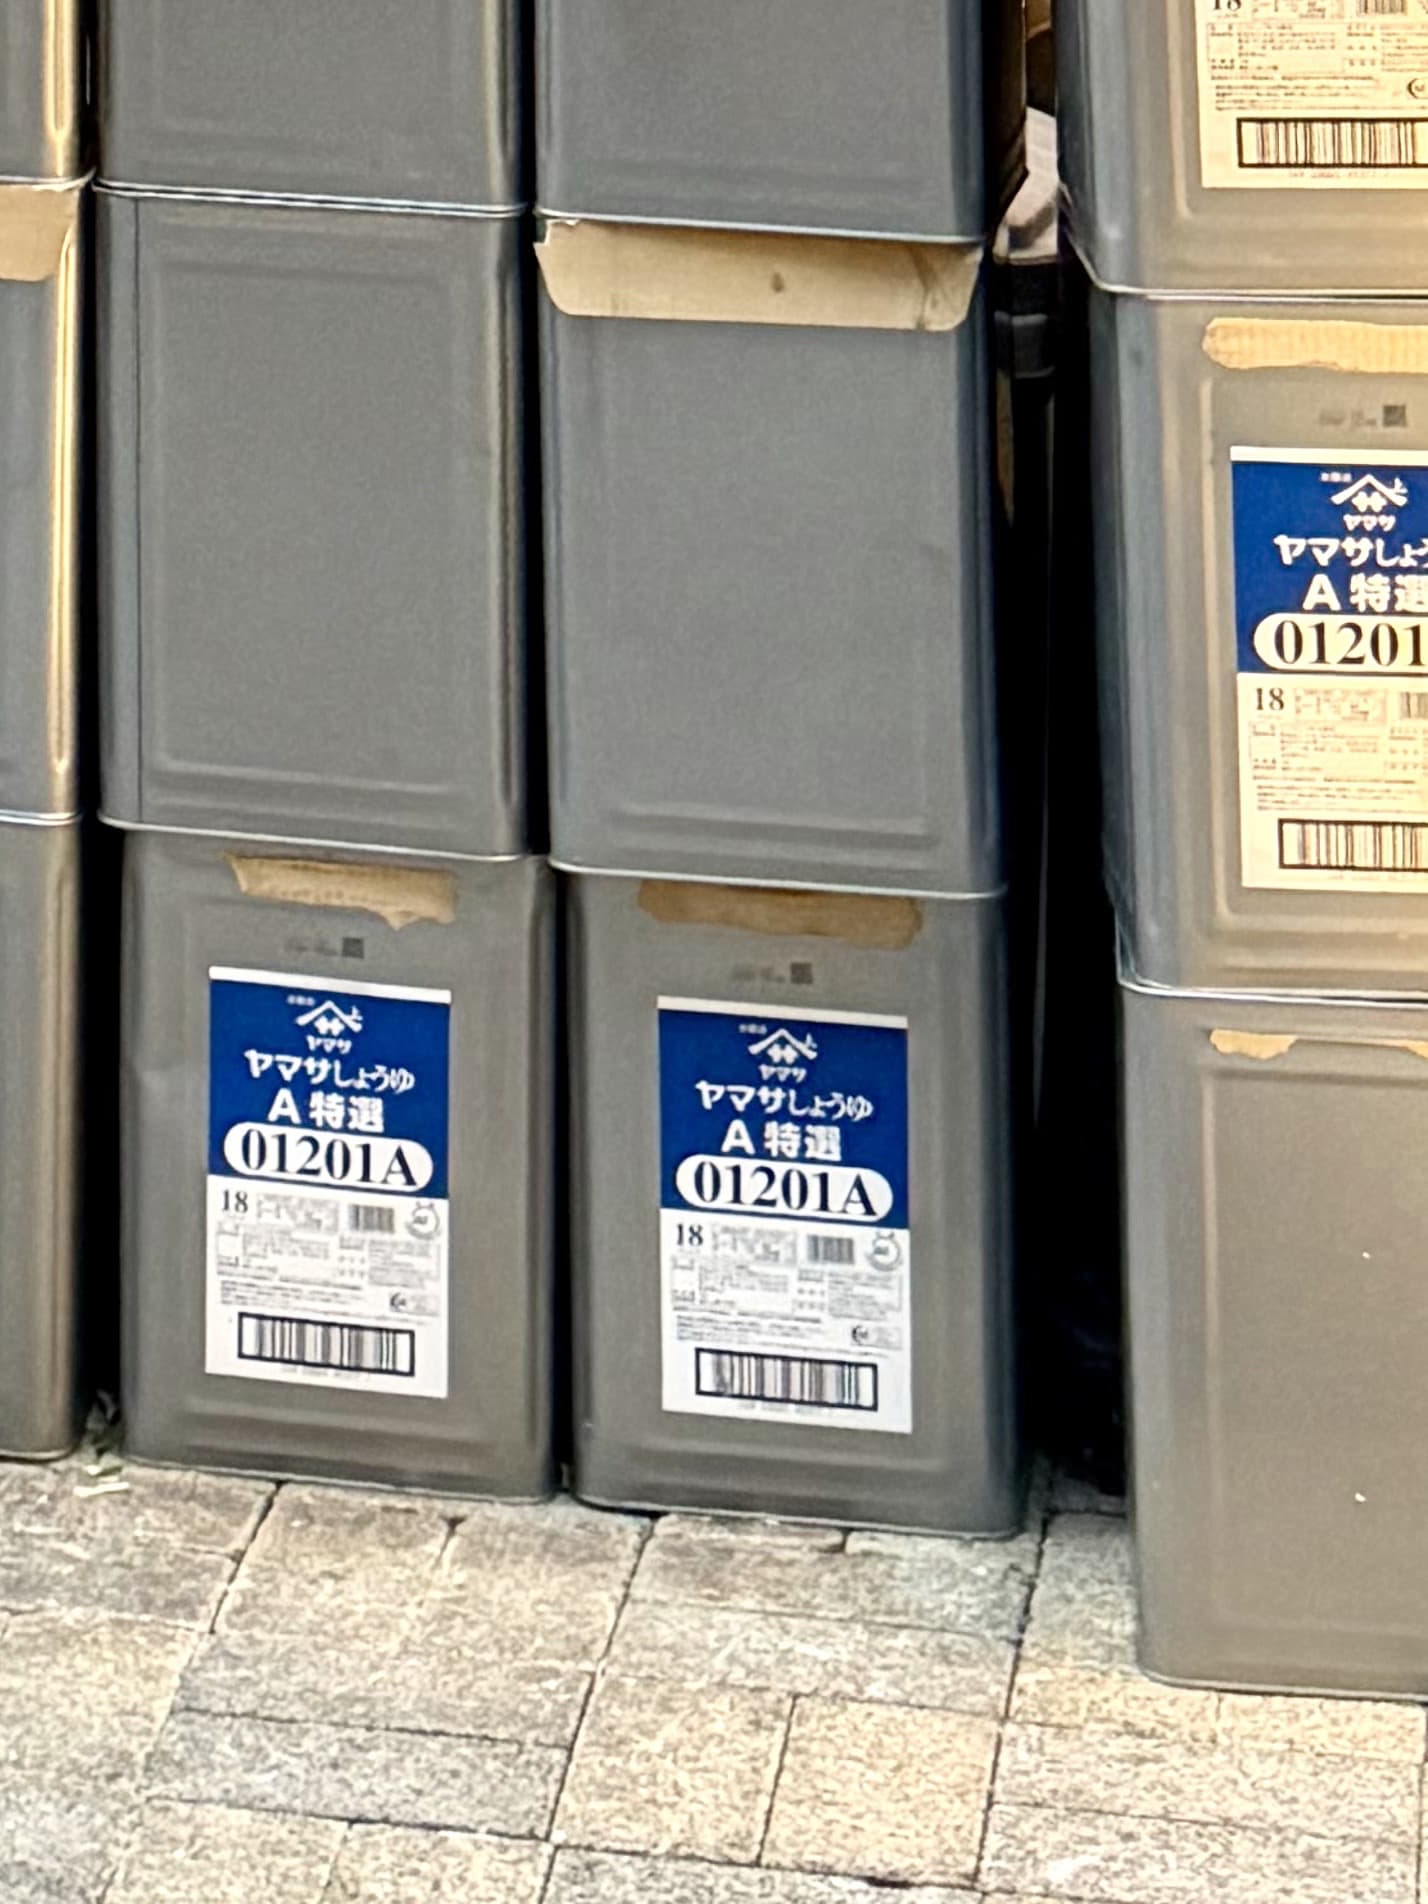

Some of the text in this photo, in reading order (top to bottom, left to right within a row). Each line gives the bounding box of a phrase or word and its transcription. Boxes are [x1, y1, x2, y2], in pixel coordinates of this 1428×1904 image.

[1342, 513, 1397, 532] ヤマサ
[1301, 573, 1342, 611] A
[1254, 686, 1286, 712] 18
[306, 1034, 353, 1055] ヤマサ
[243, 1049, 415, 1094] ヤマサしょうゆ
[758, 1063, 808, 1083] ヤマサ
[267, 1087, 385, 1134] A 特選
[694, 1079, 874, 1123] ヤマサしょうゆ
[240, 1127, 418, 1187] 01201A
[720, 1118, 843, 1162] A 特選
[220, 1188, 249, 1214] 18
[692, 1158, 877, 1217] 01201A
[674, 1223, 704, 1247] 18
